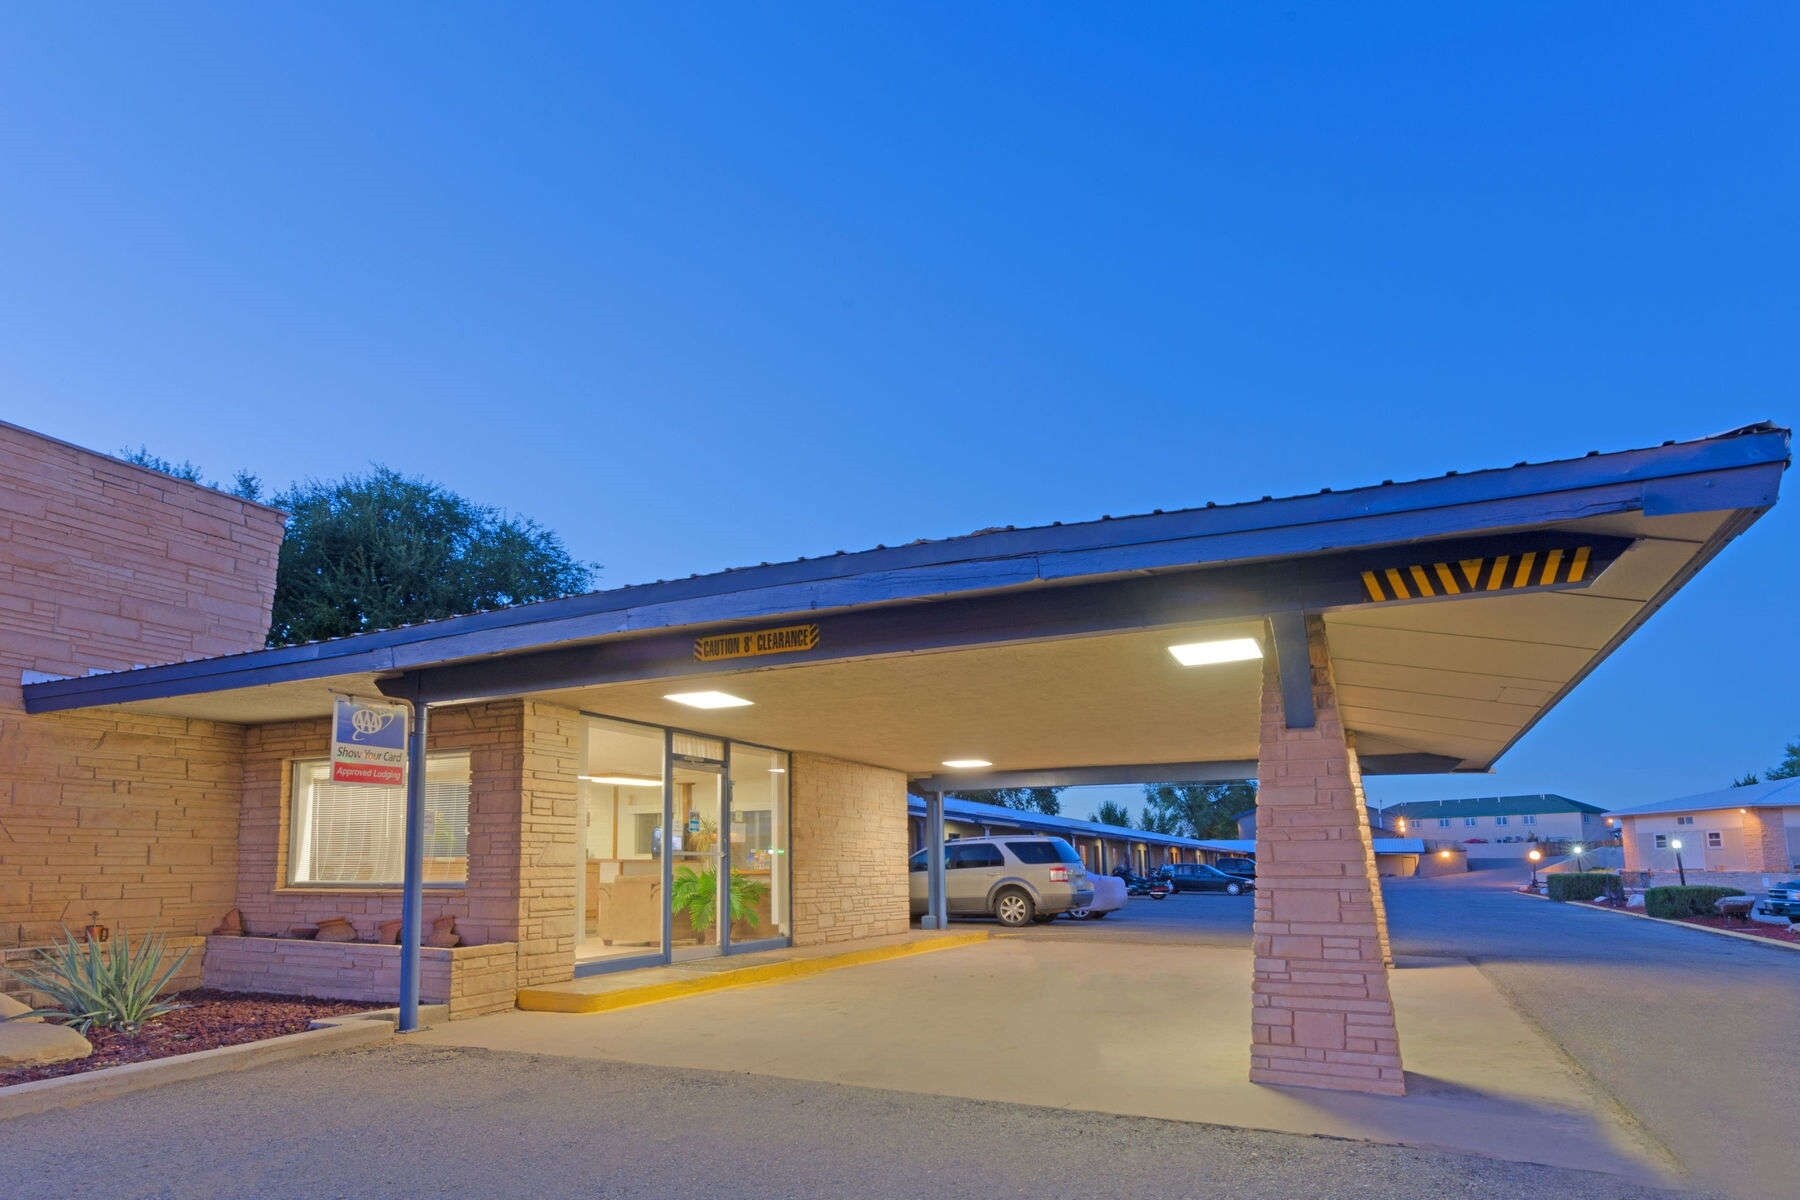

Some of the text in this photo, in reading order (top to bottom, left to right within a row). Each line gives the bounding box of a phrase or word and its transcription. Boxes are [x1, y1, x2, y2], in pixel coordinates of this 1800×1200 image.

[703, 637, 740, 657] CAUTION
[756, 629, 809, 651] CLEARANCE
[355, 711, 380, 732] AAA
[337, 746, 402, 762] Show Your Card
[336, 767, 401, 781] Approved Lodging
